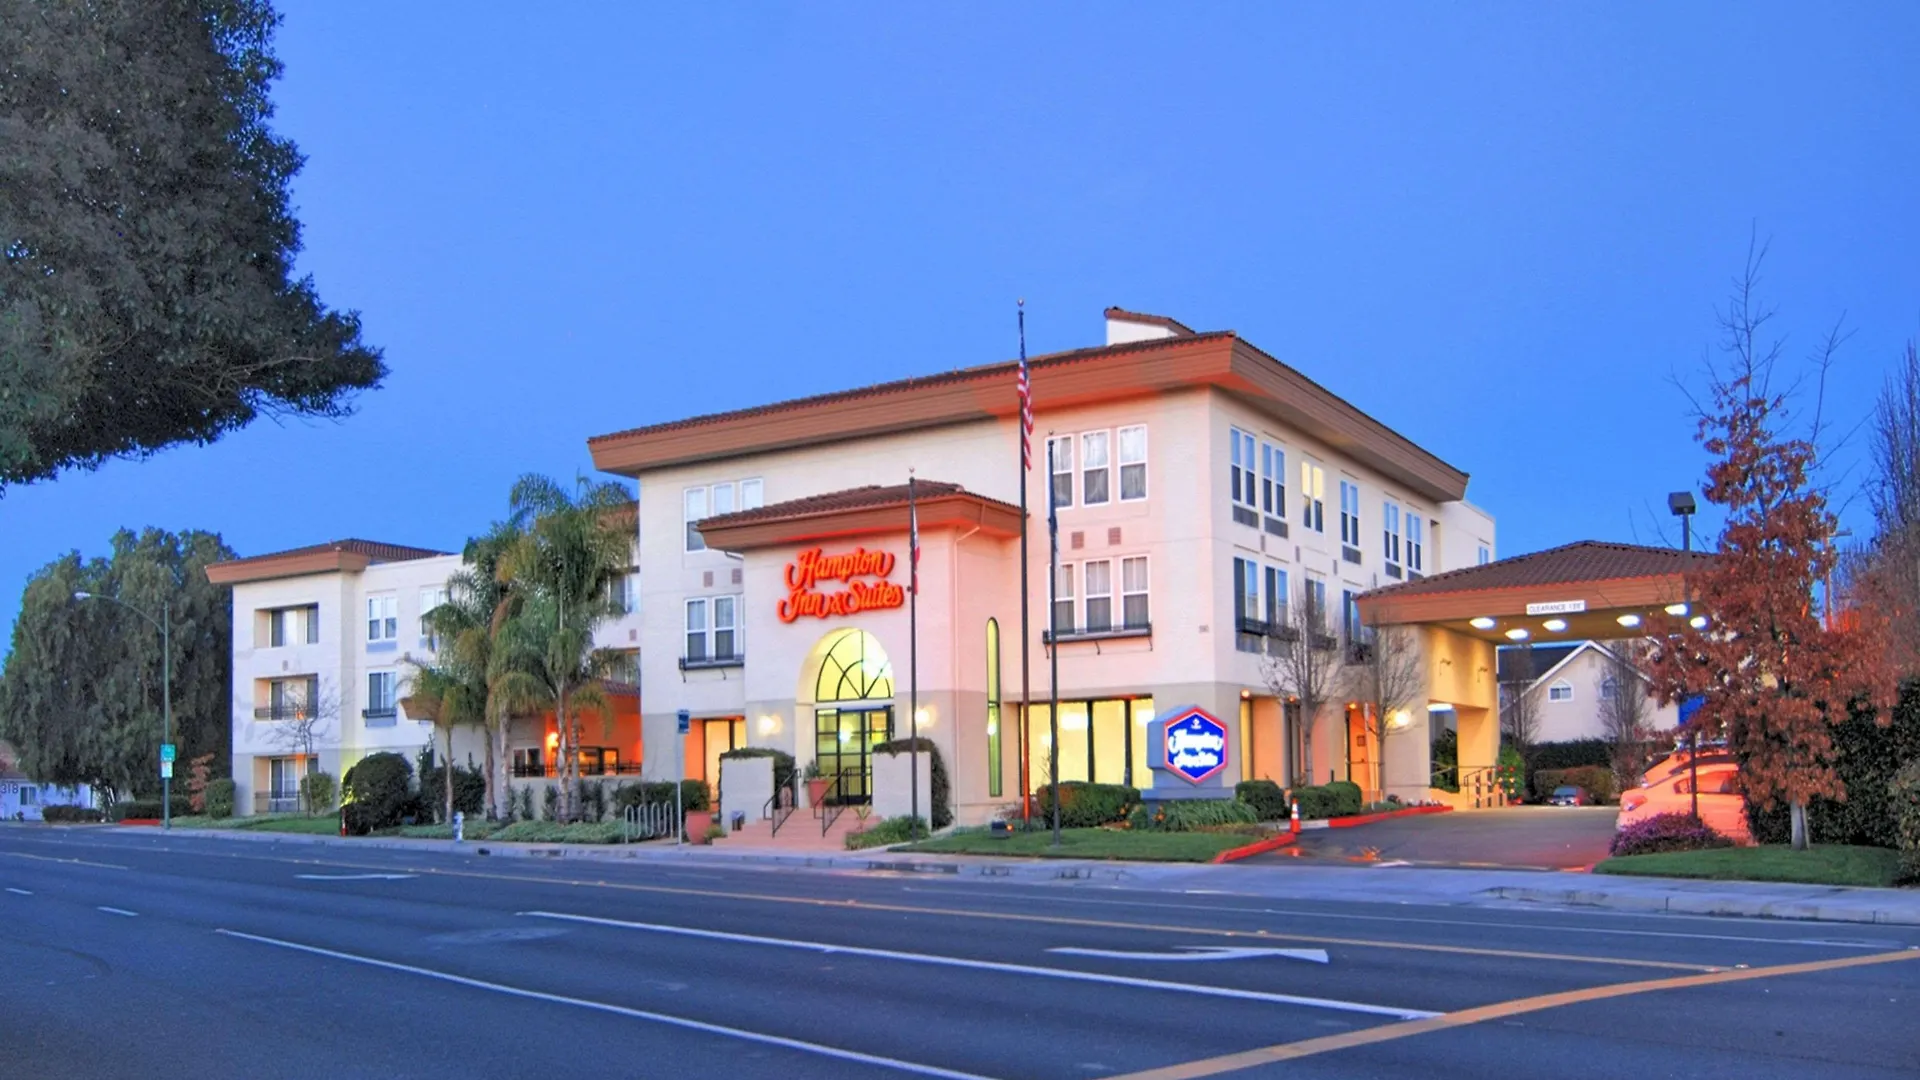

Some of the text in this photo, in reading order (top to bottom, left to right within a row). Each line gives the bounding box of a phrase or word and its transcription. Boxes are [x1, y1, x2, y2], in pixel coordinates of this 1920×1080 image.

[784, 545, 895, 589] Hampton
[776, 588, 831, 624] Inn
[842, 580, 904, 614] Suites
